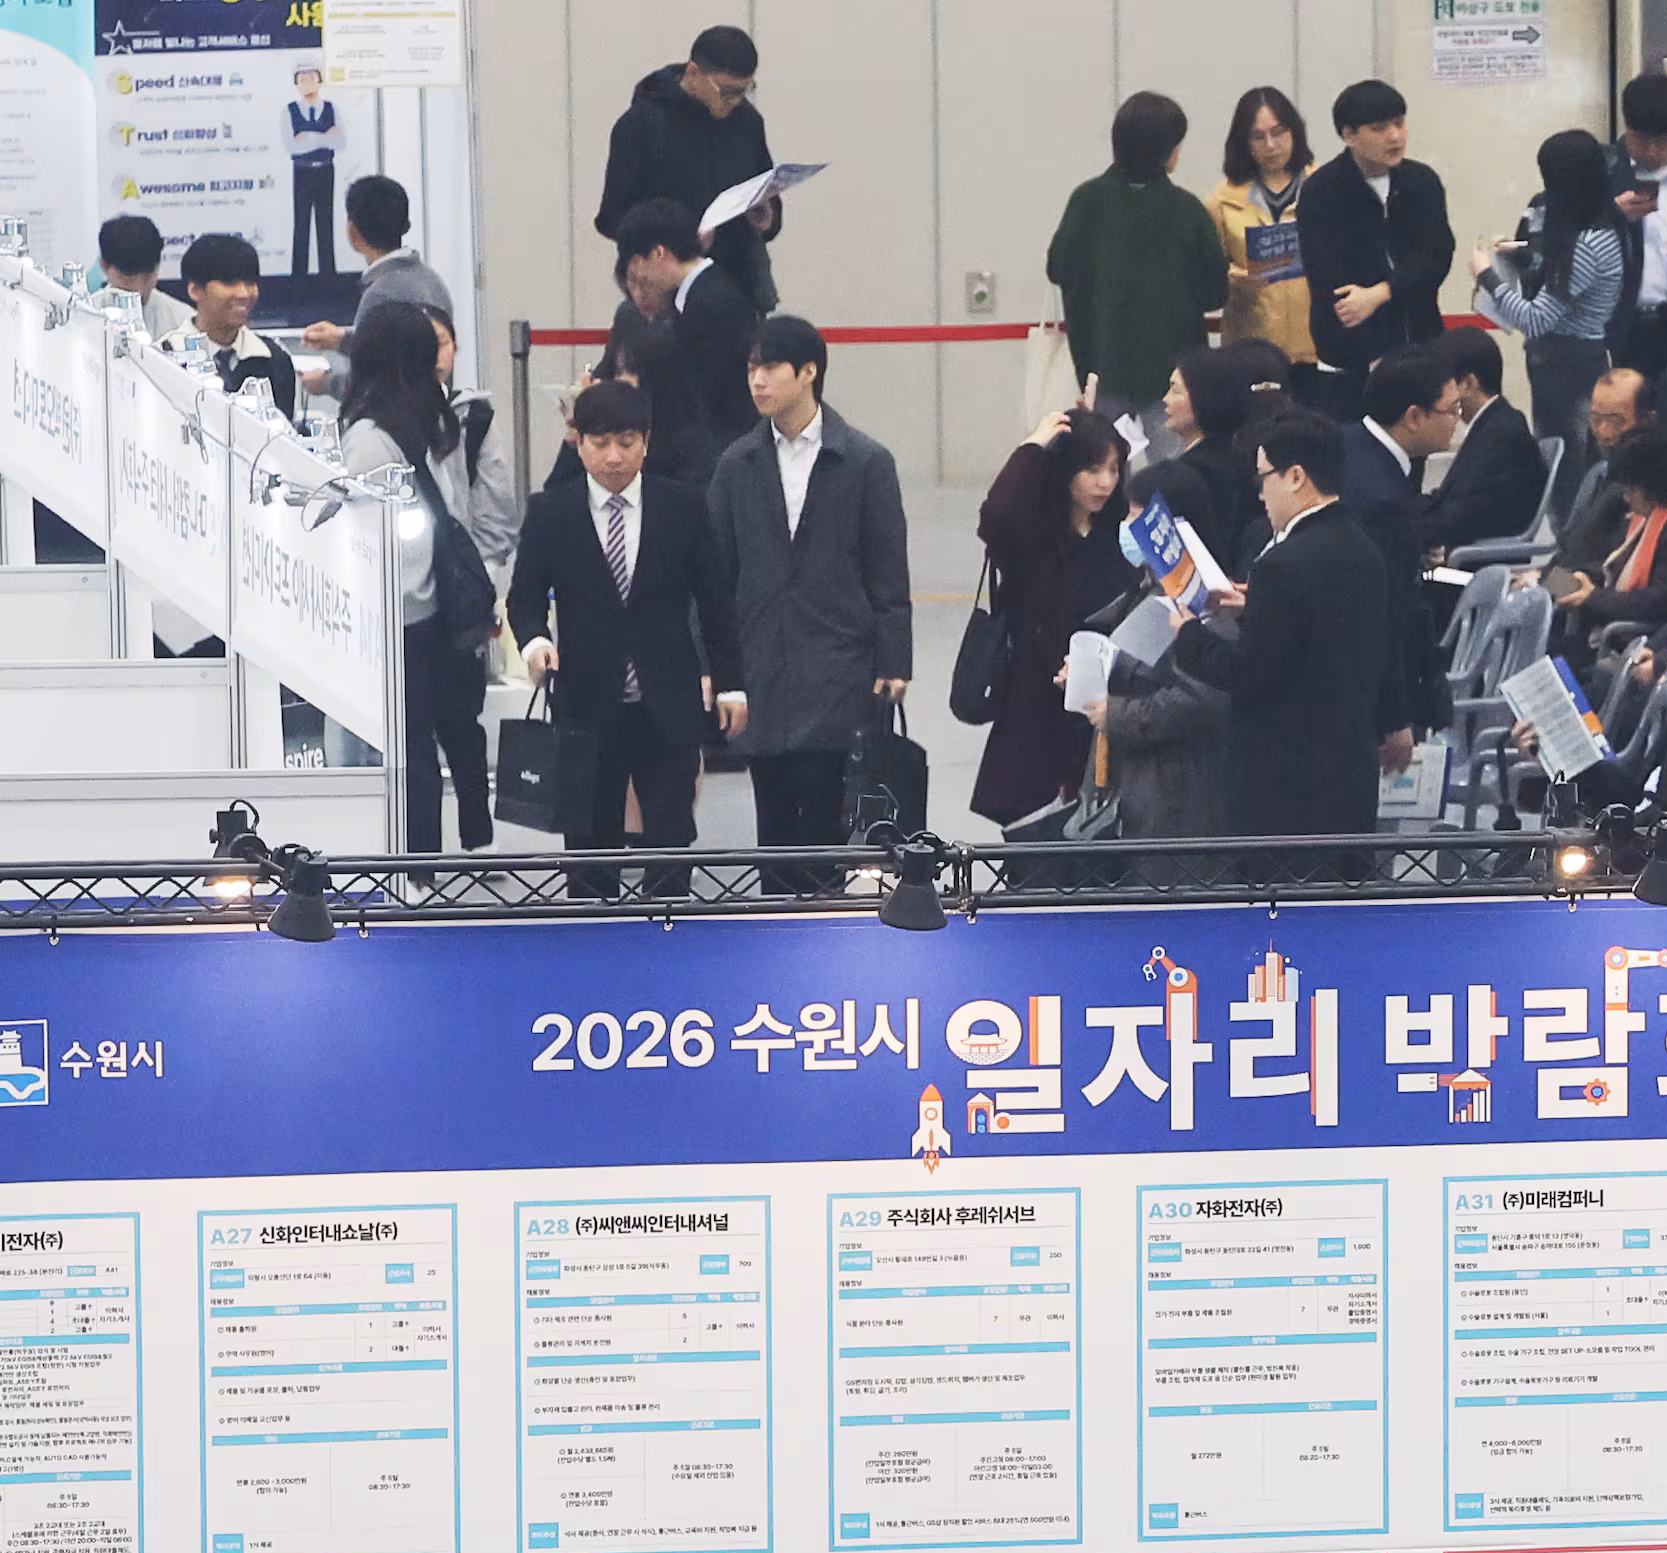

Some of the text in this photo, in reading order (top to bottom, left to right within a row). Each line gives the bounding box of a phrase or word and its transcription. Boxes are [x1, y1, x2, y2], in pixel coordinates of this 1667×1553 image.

[530, 999, 923, 1074] 2026 수원시
[59, 1039, 166, 1081] 수원시
[945, 988, 1340, 1136] 일자리
[1148, 1198, 1283, 1219] A30 자화전자(주)
[1455, 1189, 1604, 1210] A31 (주)미래컴퍼니
[526, 1212, 729, 1236] A28 (주)씨앤씨인터내셔널
[839, 1205, 1036, 1227] A29 주식회사 후레쉬서브
[0, 1229, 63, 1251] 전자(주)
[210, 1221, 398, 1246] A27 신화인터내쇼날(주)
